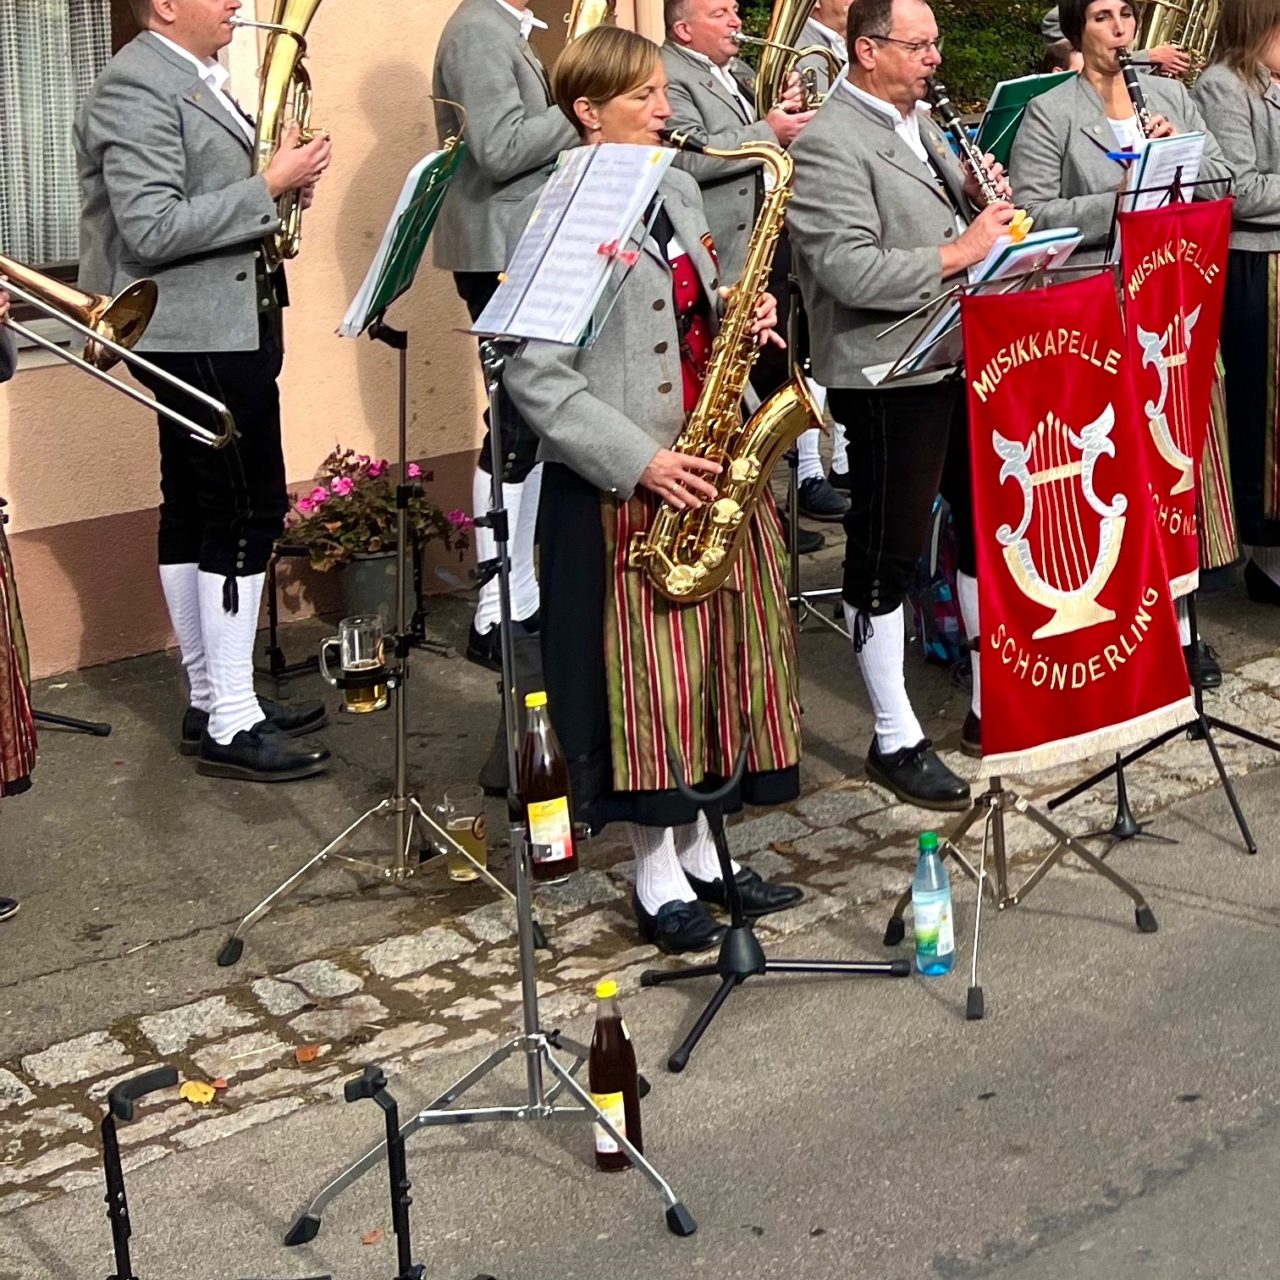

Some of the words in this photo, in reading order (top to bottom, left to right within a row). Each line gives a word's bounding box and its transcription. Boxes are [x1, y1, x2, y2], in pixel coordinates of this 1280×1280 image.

[1127, 238, 1220, 301] MUSIKKPELLE
[972, 328, 1122, 403] MUSIKKAPELLE
[991, 586, 1159, 690] SCHÖNDERLING
